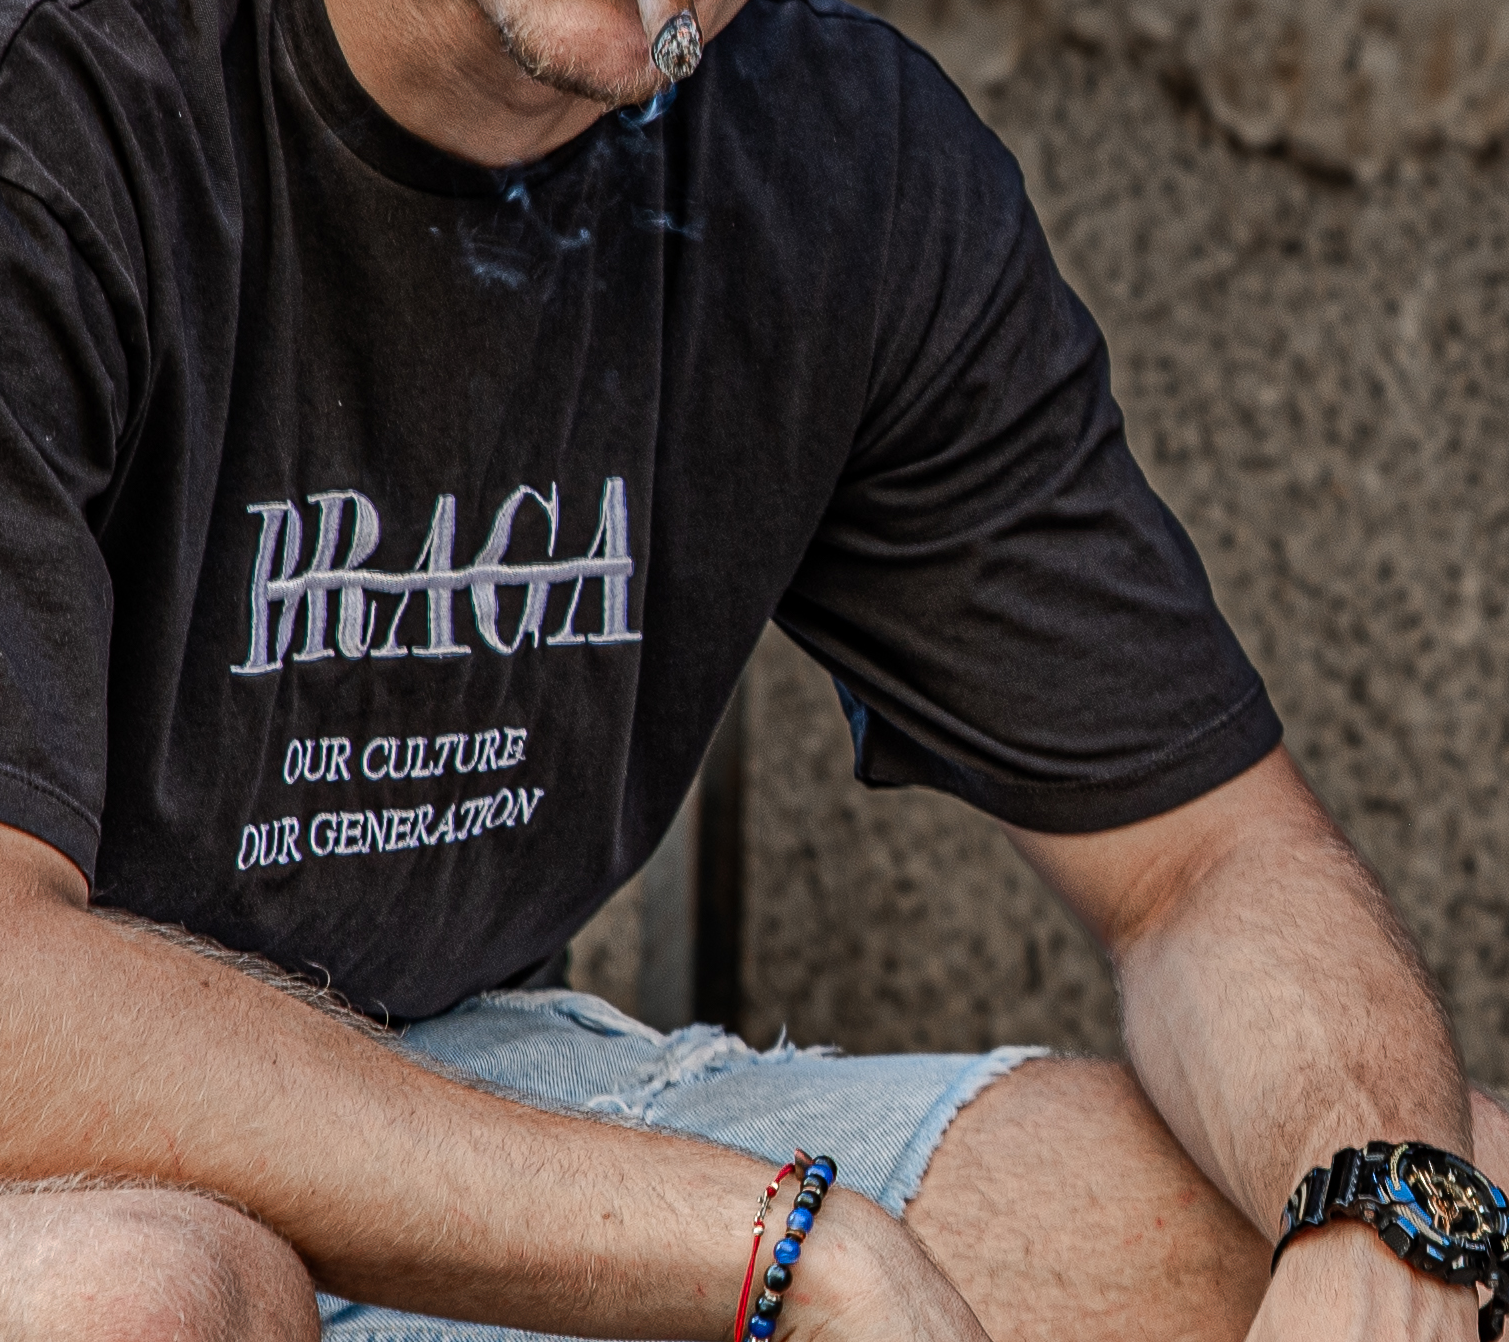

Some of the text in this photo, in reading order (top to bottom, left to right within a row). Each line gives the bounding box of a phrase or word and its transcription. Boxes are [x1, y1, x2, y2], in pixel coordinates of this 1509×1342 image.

[229, 476, 643, 677] BRAGA
[282, 726, 528, 785] OUR CULTURE
[237, 787, 545, 871] OUR GENERATION
